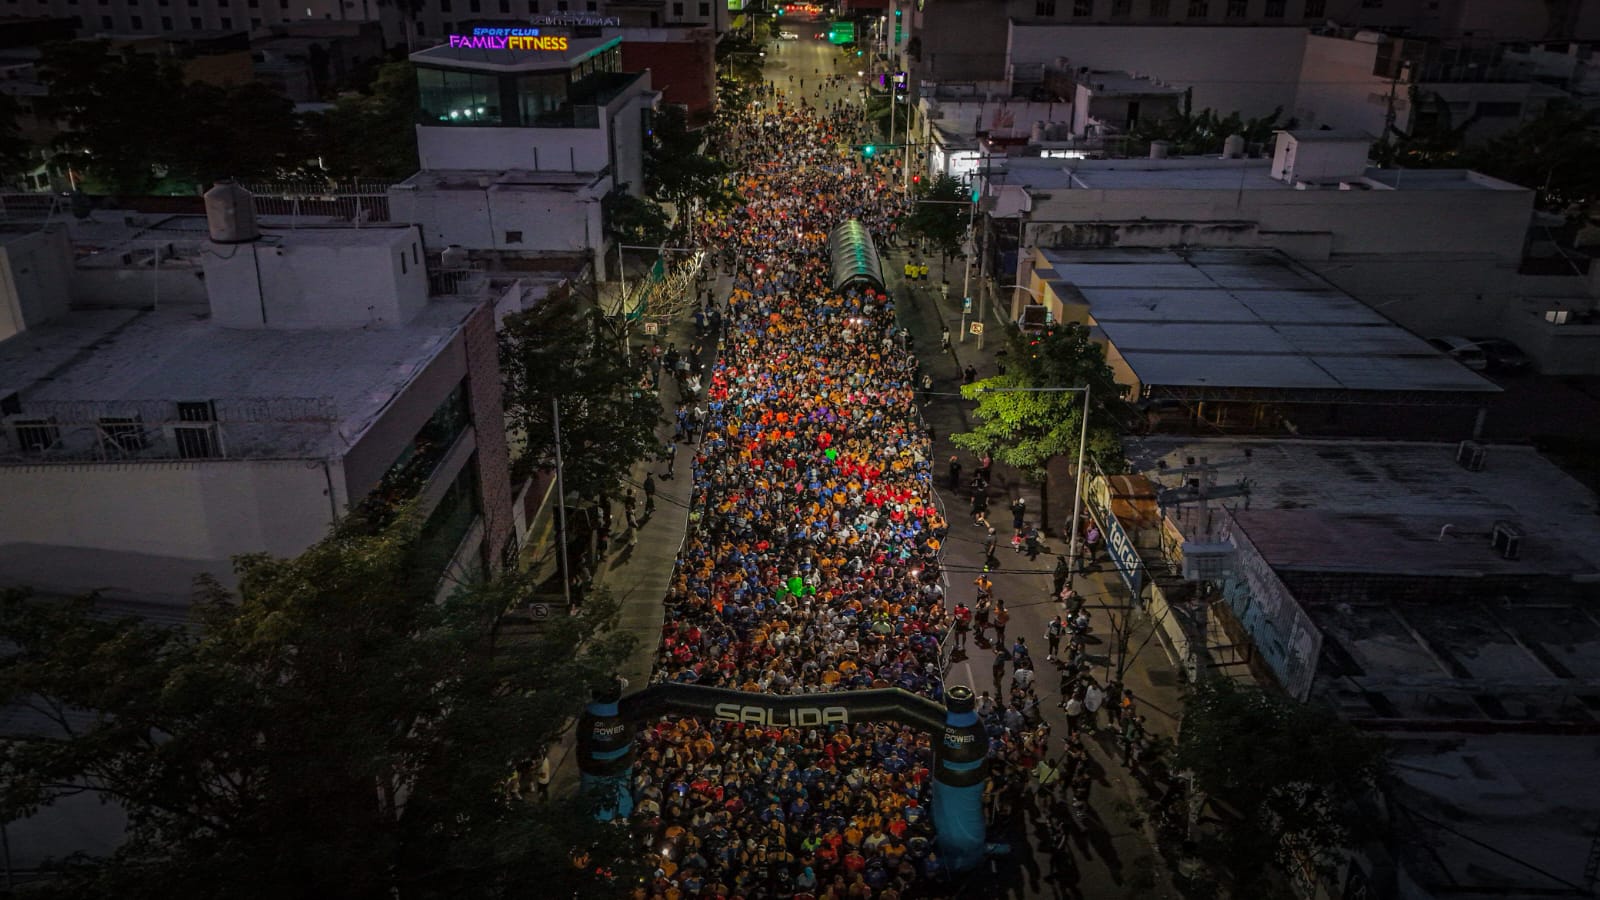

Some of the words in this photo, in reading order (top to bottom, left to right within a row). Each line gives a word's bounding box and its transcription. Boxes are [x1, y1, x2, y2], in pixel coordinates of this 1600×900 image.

[473, 28, 510, 36] SPORT
[511, 28, 540, 36] CLUB
[1110, 521, 1139, 577] telcel
[714, 702, 849, 727] SALIDA
[592, 724, 625, 735] POWER
[944, 733, 975, 743] POWER
